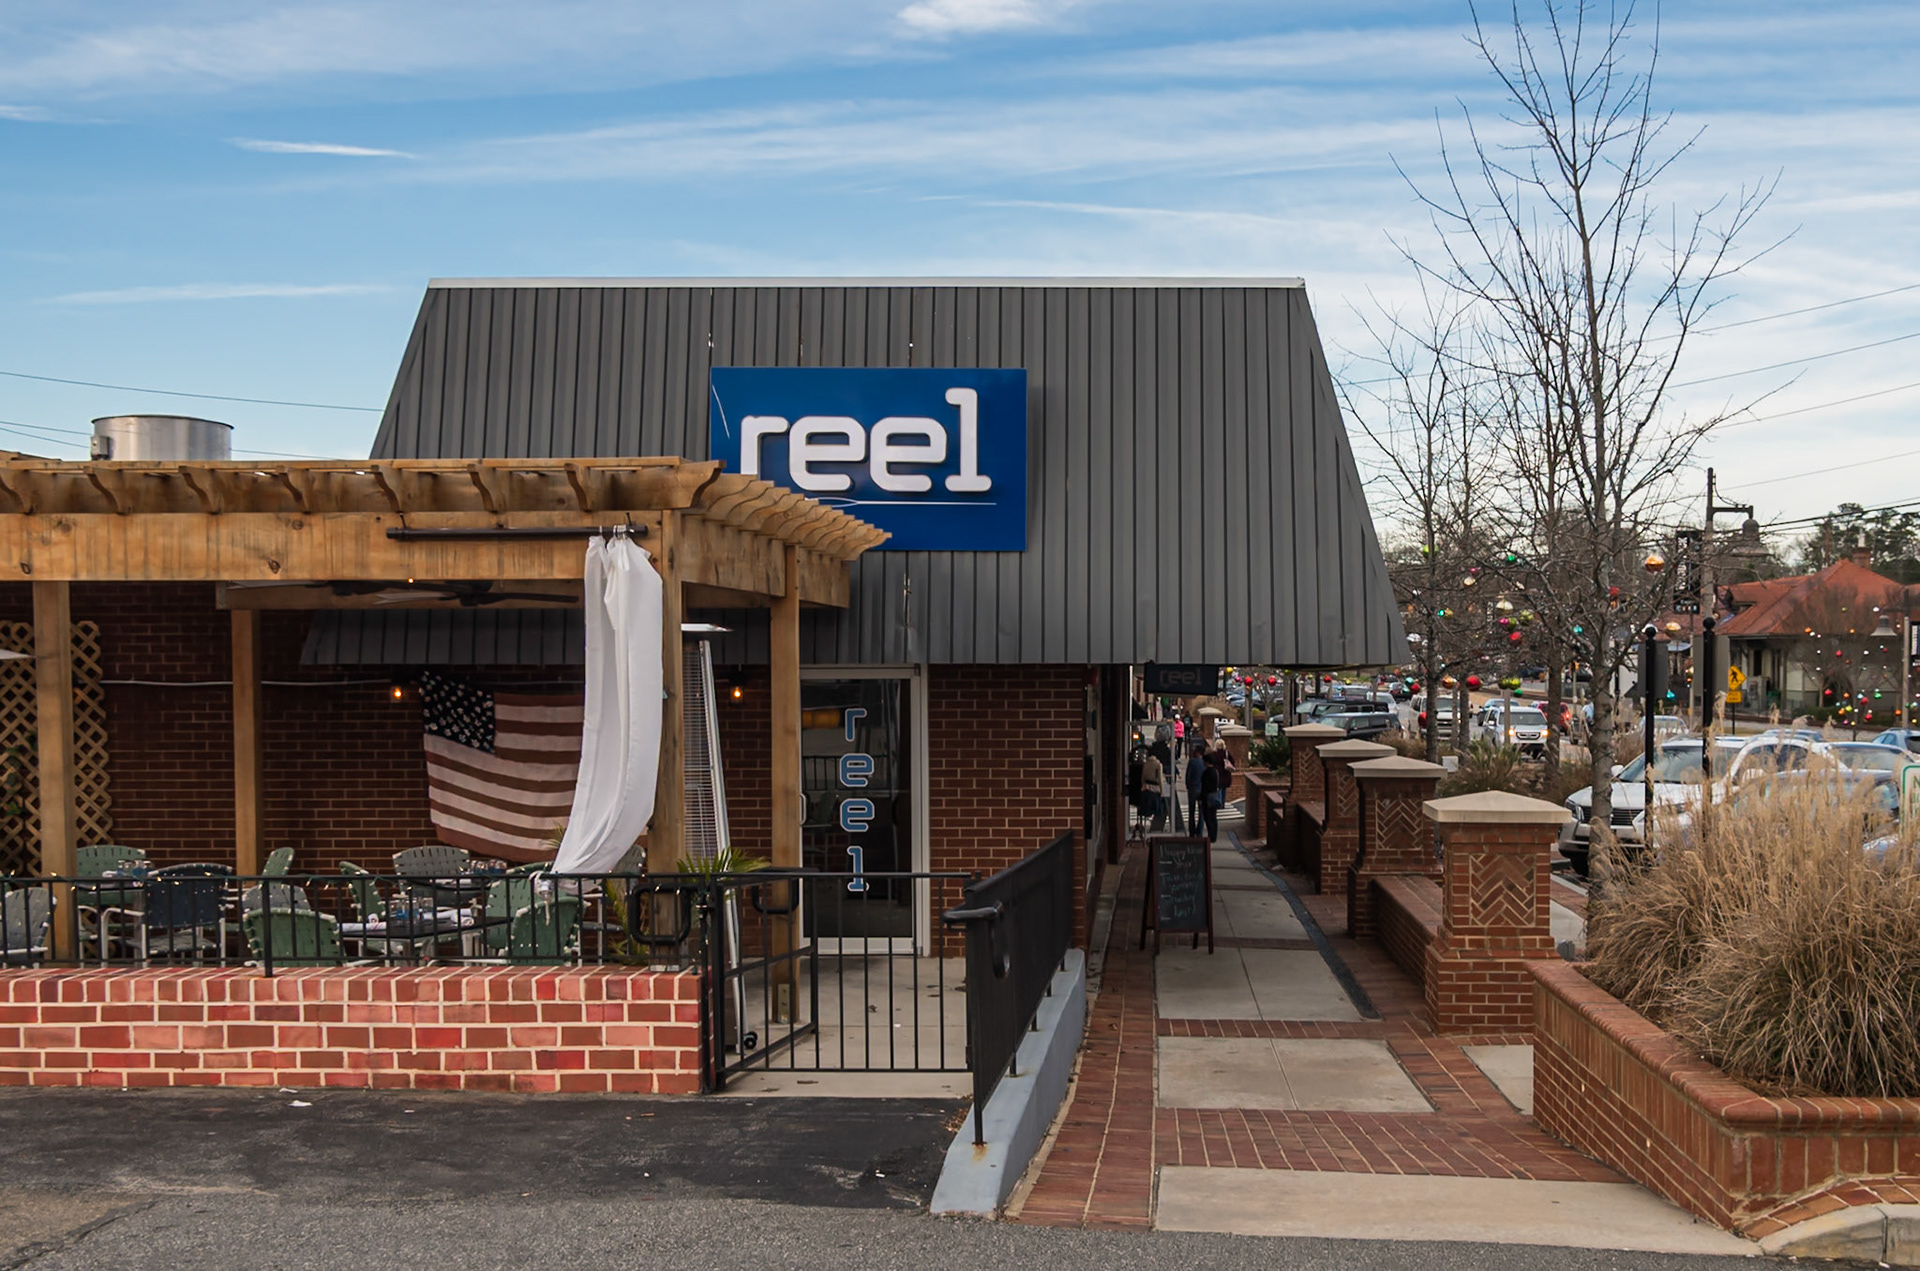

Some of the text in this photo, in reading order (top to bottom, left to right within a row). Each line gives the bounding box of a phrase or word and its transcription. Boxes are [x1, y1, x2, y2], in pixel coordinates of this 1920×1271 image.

[740, 387, 992, 492] reel
[1159, 666, 1202, 688] reel
[839, 707, 875, 892] reel
